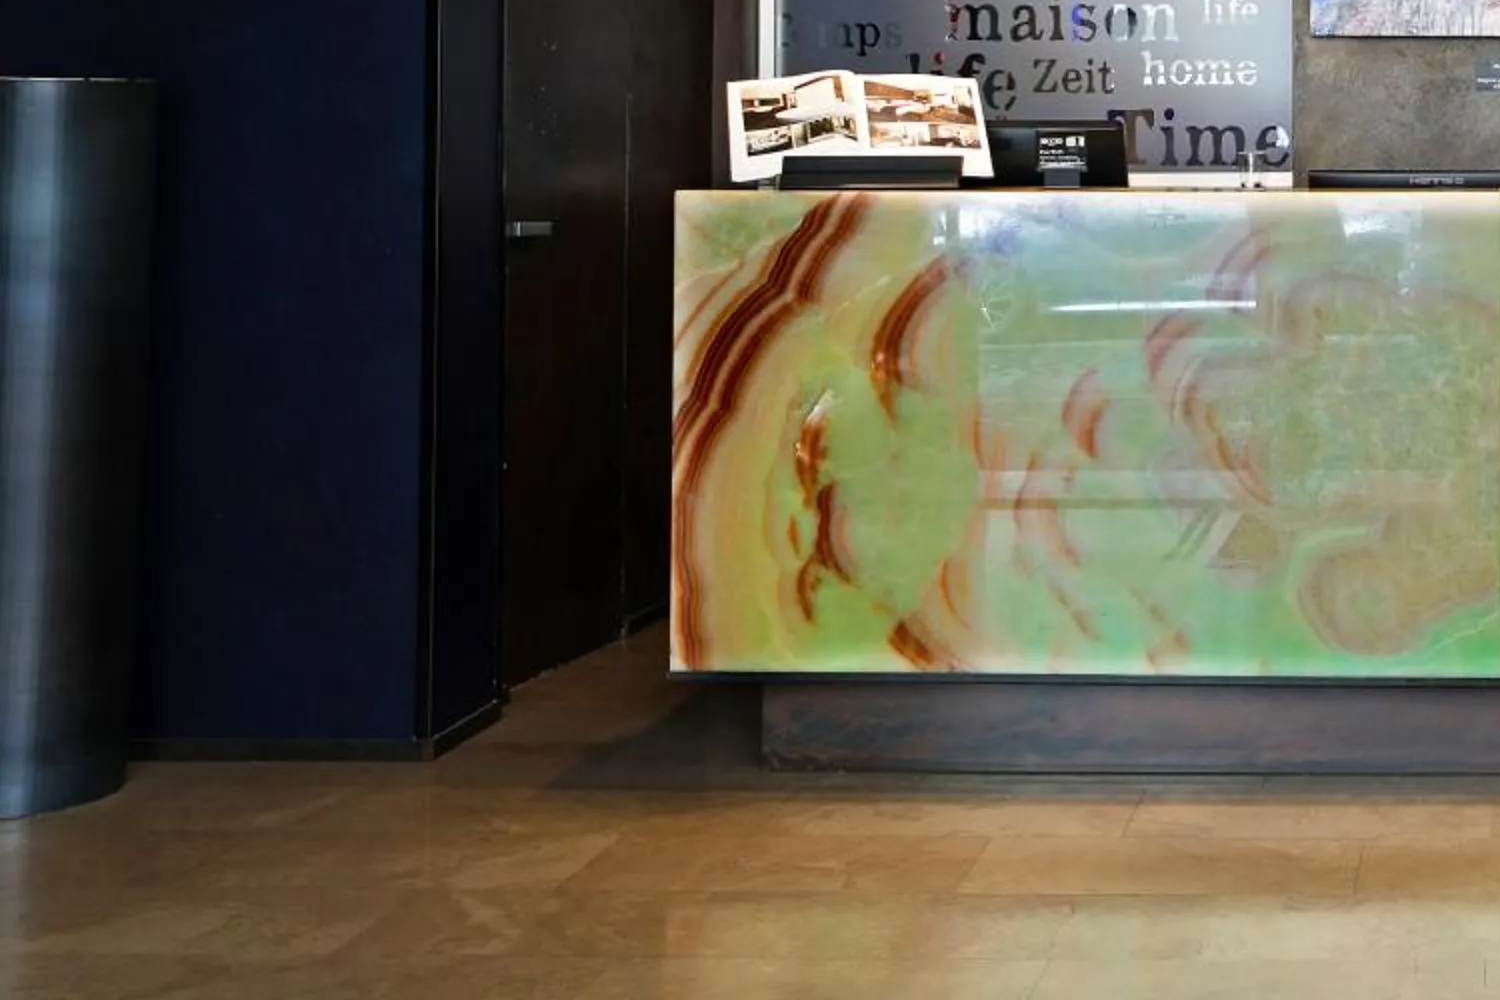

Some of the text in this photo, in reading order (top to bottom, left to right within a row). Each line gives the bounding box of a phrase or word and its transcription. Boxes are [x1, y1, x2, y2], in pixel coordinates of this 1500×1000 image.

[1033, 58, 1115, 95] Zeit
[1141, 51, 1258, 87] home
[1107, 107, 1290, 168] Time
